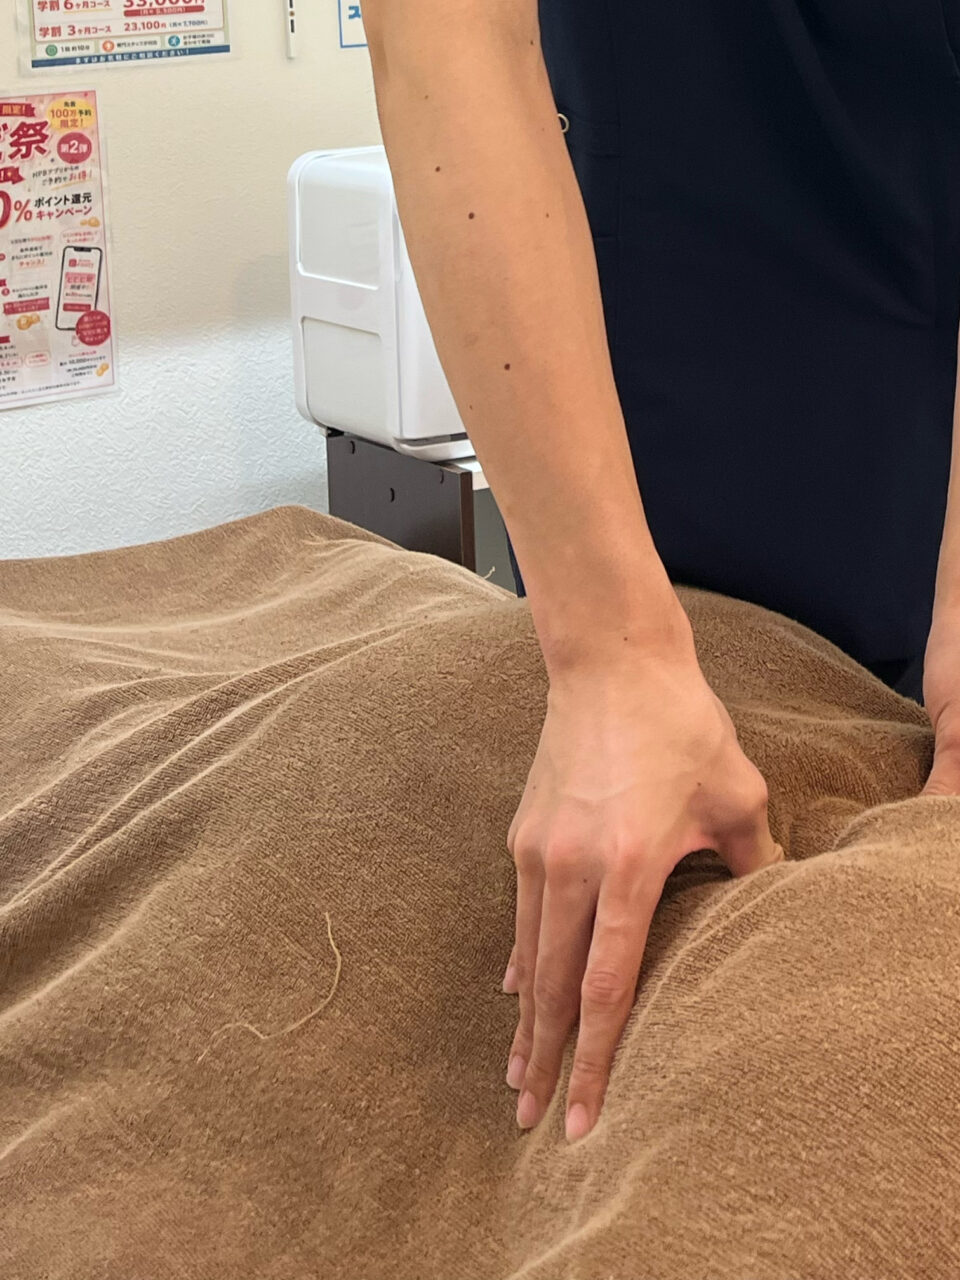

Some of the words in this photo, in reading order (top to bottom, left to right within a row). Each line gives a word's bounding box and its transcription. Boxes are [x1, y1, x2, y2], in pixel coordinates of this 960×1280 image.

[124, 20, 167, 32] 23,100円
[60, 140, 88, 154] 第2弾
[34, 192, 92, 208] ポイント還元
[36, 206, 92, 220] キャンペーン
